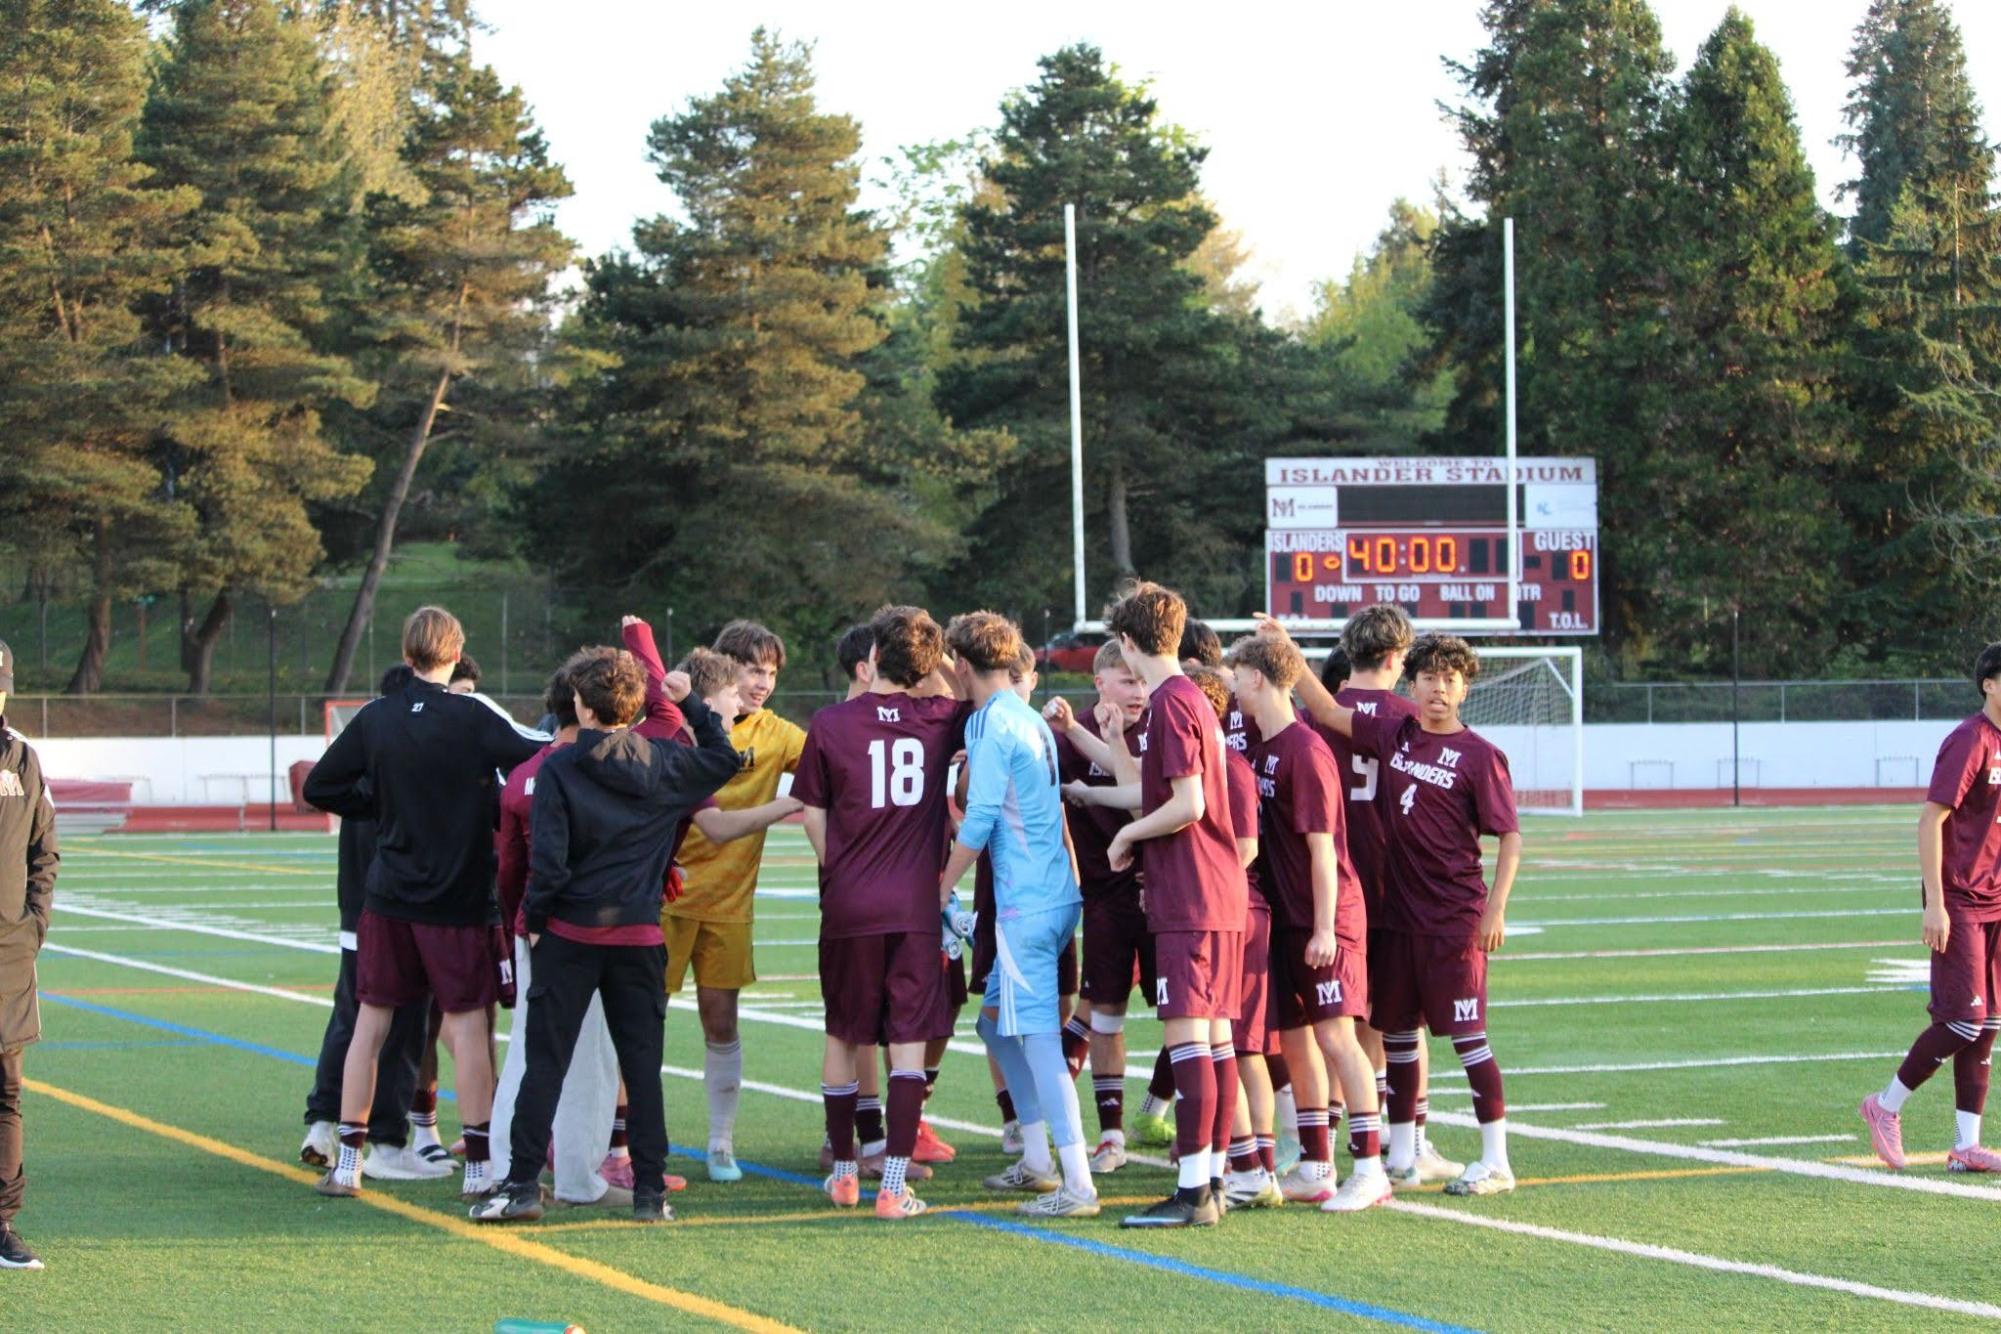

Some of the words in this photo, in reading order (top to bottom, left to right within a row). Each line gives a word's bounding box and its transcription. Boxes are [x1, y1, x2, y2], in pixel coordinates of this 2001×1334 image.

[1378, 459, 1463, 467] WELCOME
[1280, 468, 1433, 482] ISLANDER
[1534, 532, 1593, 551] GUEST
[1296, 552, 1313, 582] 0
[1572, 550, 1590, 580] 0
[1314, 585, 1362, 602] DOWN
[1375, 585, 1395, 602] TO
[1398, 585, 1420, 602] GO
[1440, 585, 1472, 602] BALL
[1475, 585, 1495, 601] ON
[1549, 613, 1588, 629] T.O.L.
[867, 738, 924, 808] 18
[1400, 783, 1417, 815] 4
